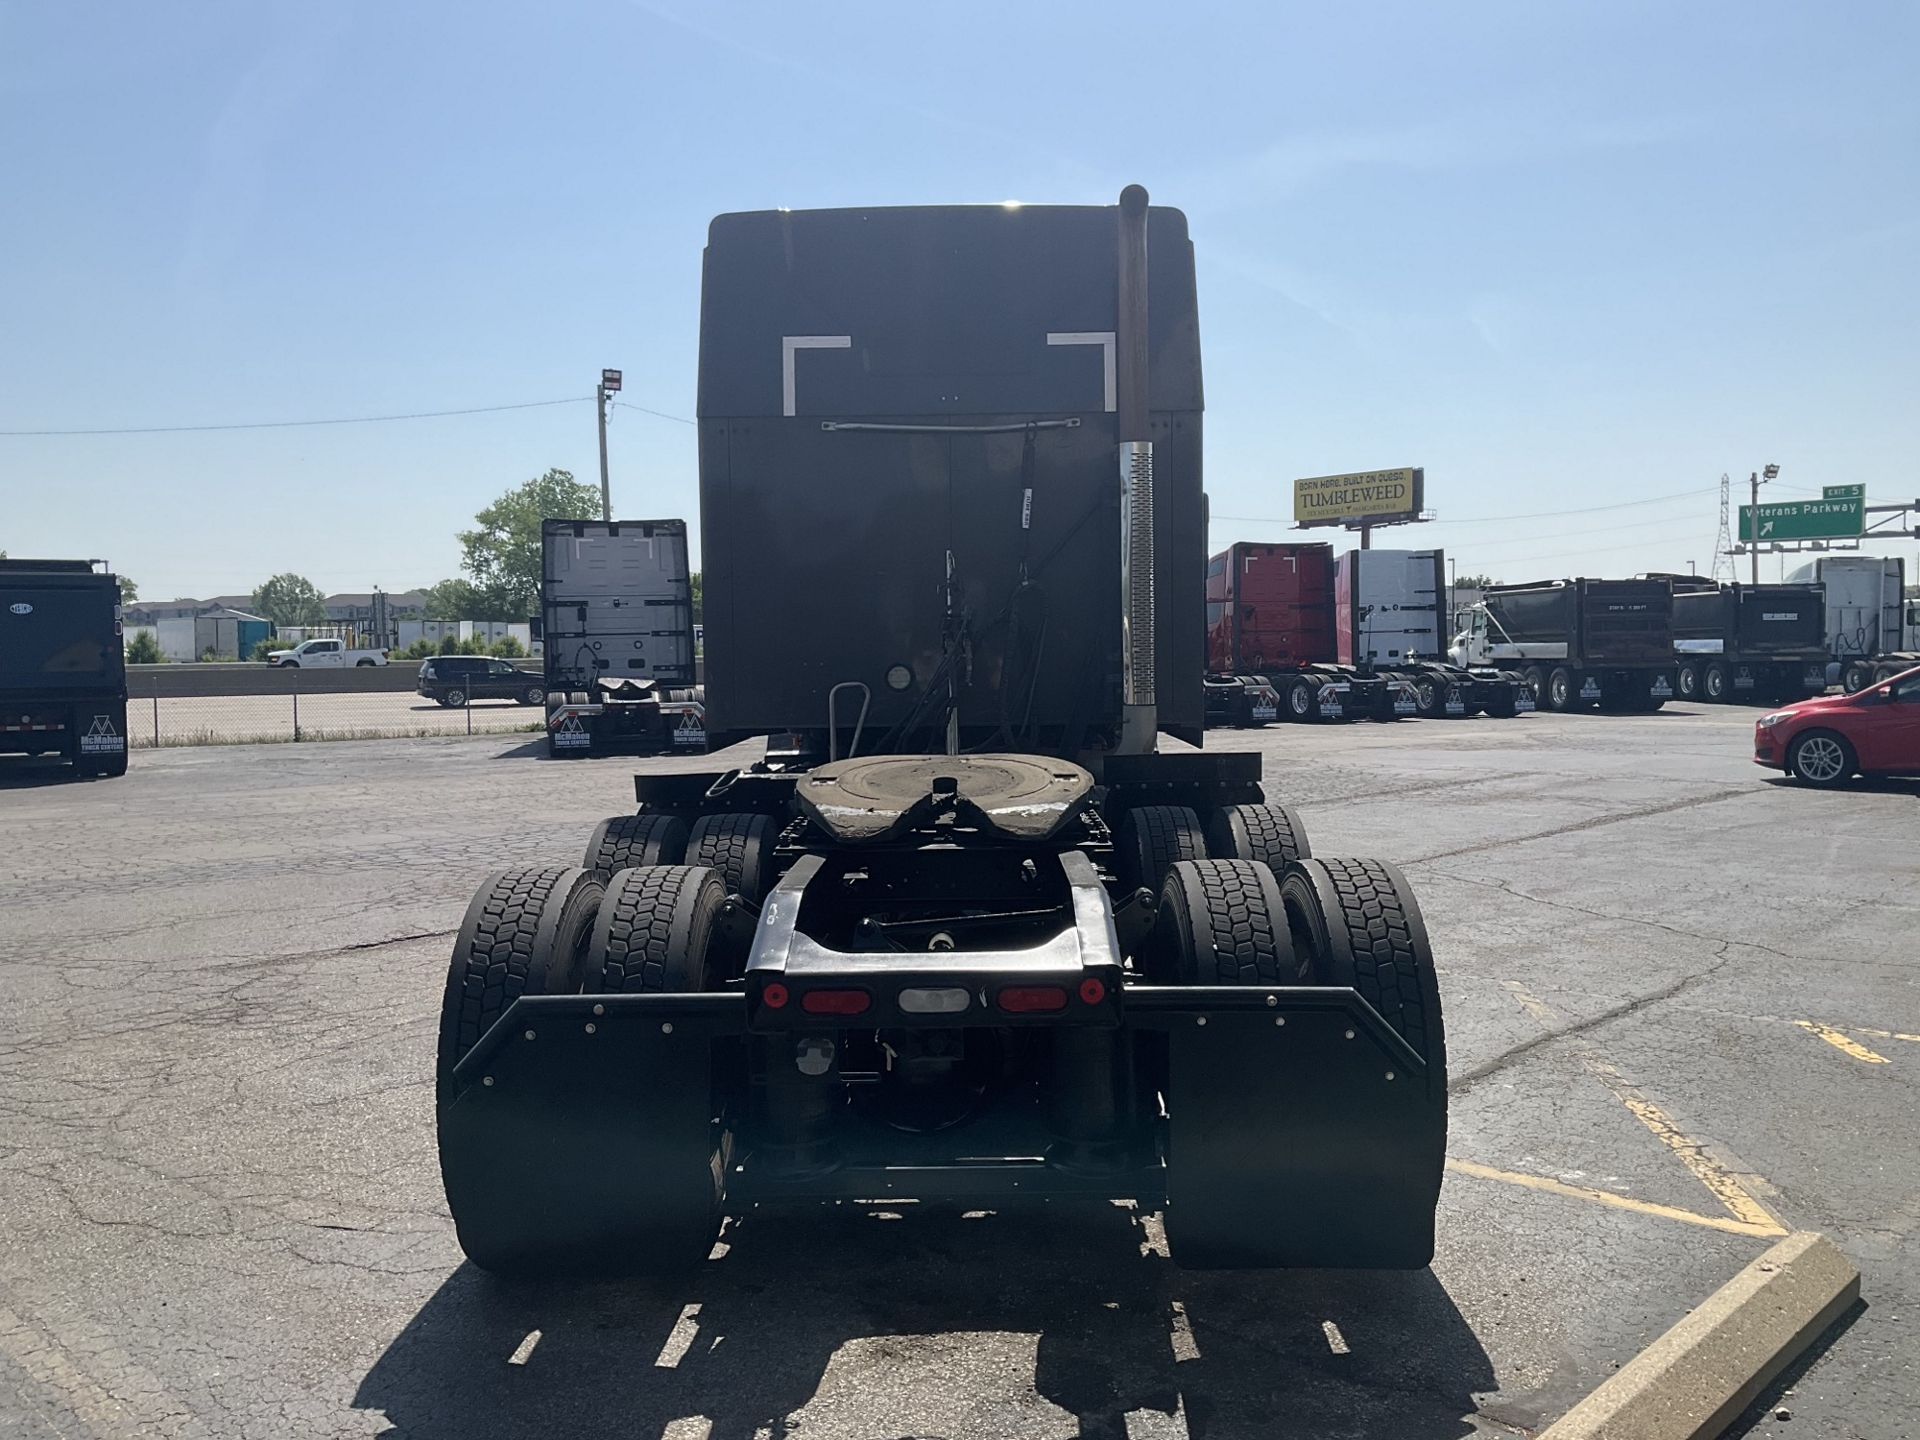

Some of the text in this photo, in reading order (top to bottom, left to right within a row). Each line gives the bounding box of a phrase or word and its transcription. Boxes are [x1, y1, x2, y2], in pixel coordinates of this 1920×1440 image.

[1299, 481, 1319, 491] BORN
[1343, 476, 1364, 487] BUILT
[1366, 474, 1377, 484] ON
[1300, 483, 1406, 509] TUMBLEWEED
[1828, 486, 1860, 496] EXIT 5
[1746, 503, 1857, 518] Vterans Parkway
[81, 735, 124, 744] McMahon
